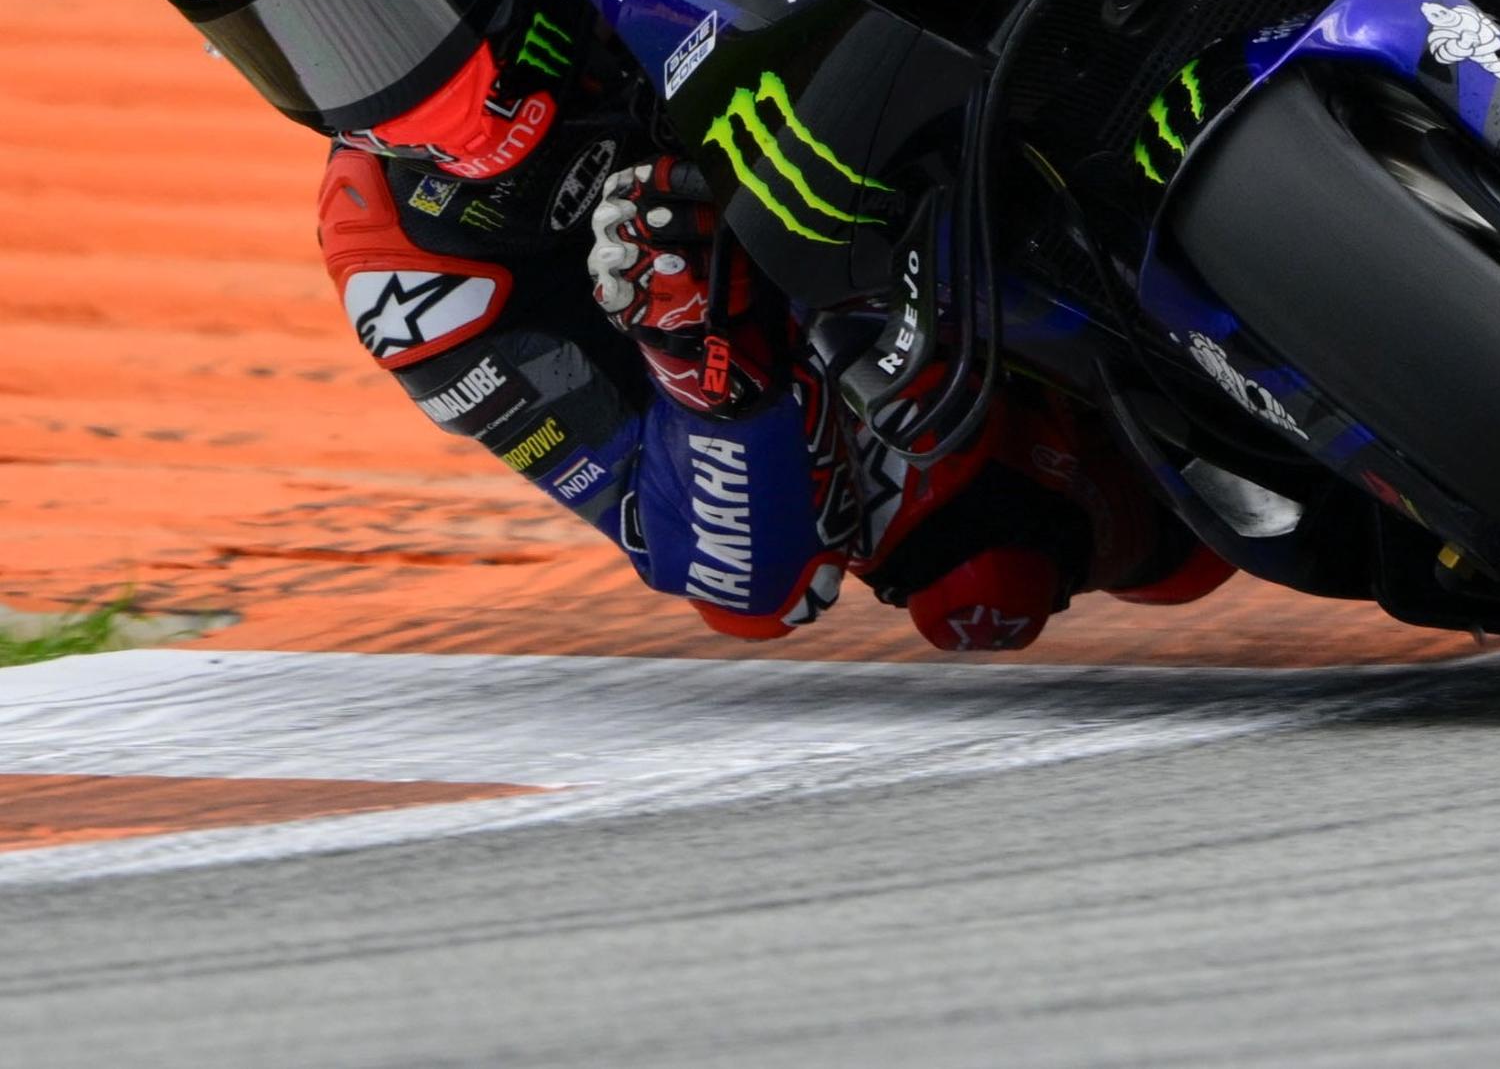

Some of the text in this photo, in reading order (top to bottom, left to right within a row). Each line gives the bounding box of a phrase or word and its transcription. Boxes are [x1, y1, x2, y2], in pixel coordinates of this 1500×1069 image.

[447, 98, 547, 179] prima
[877, 250, 920, 376] REEJO
[557, 461, 607, 500] INDIA
[686, 434, 752, 610] YAMAHA
